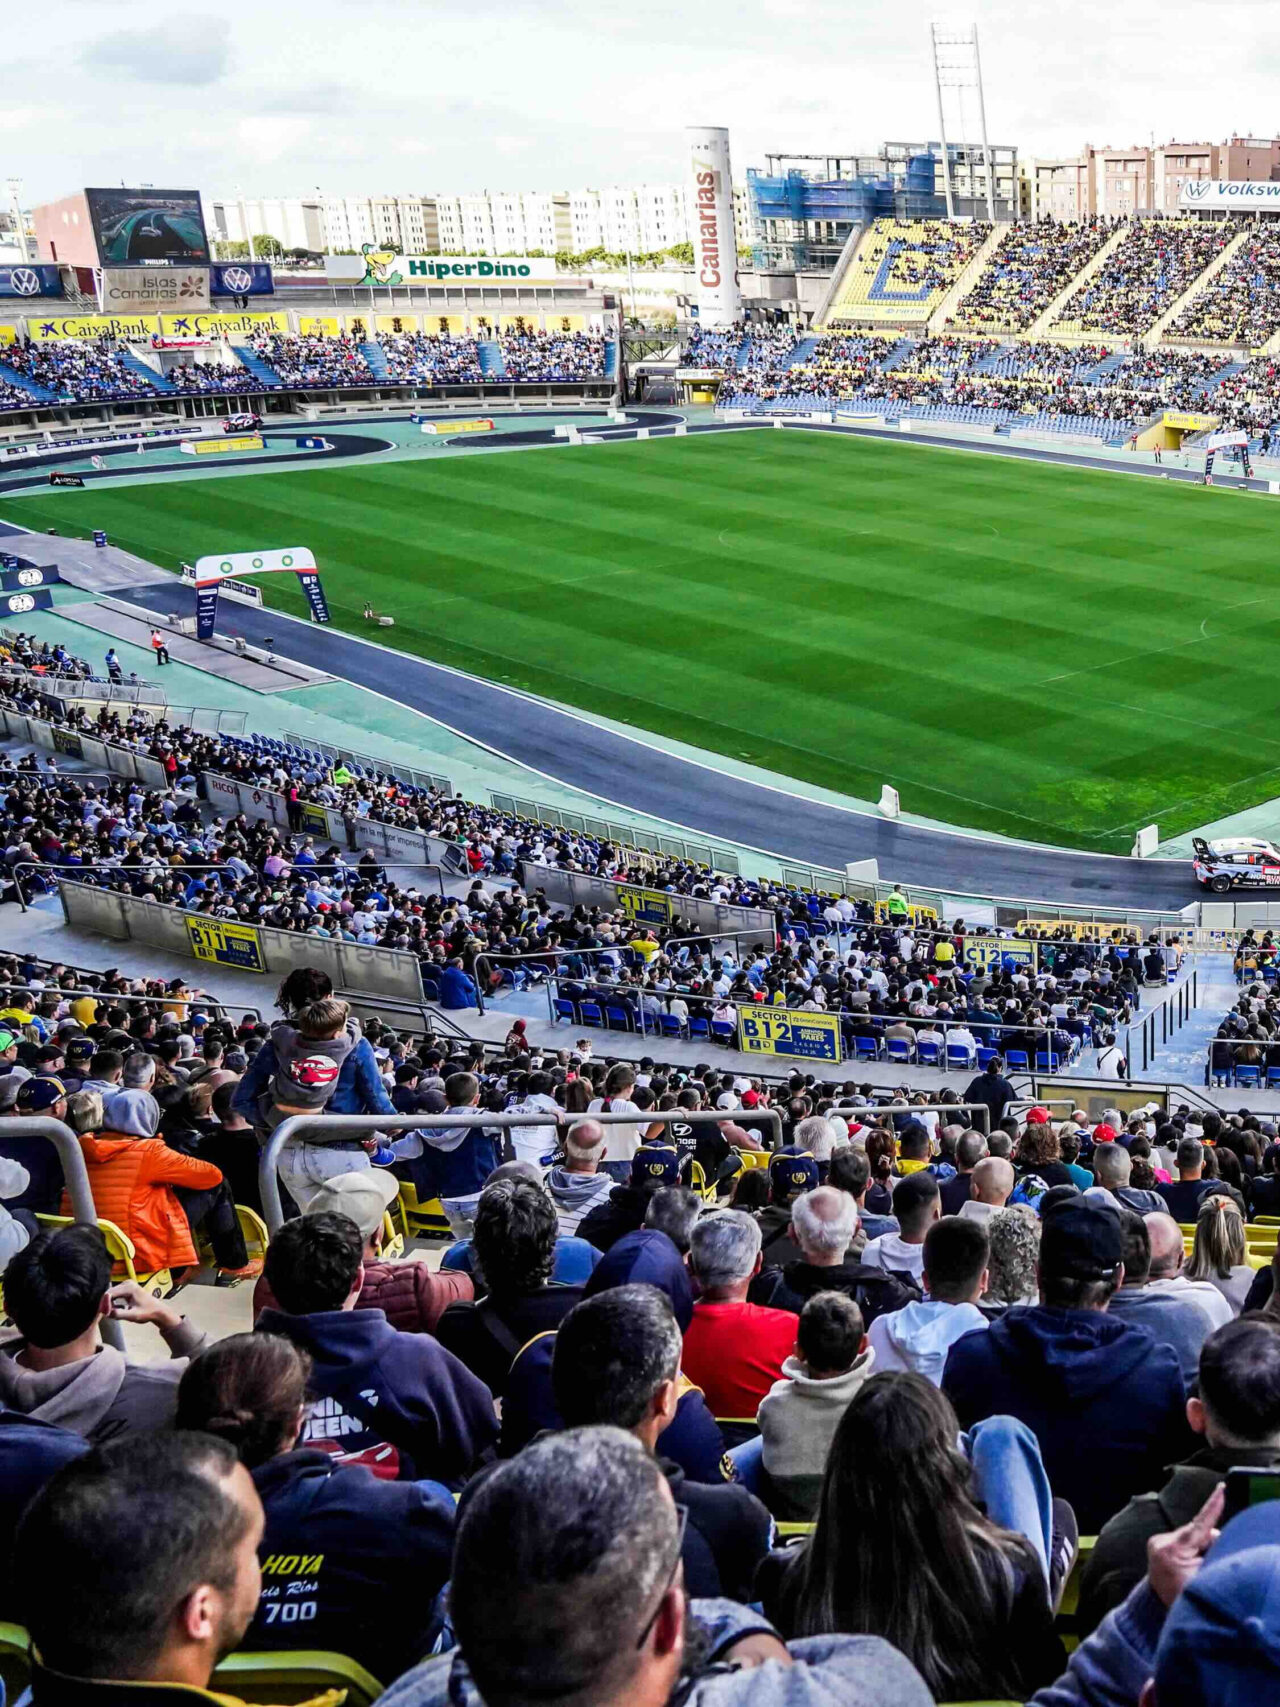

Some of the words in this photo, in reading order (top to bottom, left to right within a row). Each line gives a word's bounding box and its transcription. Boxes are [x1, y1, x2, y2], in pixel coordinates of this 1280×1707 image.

[409, 260, 531, 279] HiperDino
[143, 276, 177, 288] Islas
[109, 287, 177, 299] Canarias
[62, 319, 150, 337] CaixaBank
[194, 316, 280, 333] CaixaBank
[195, 920, 221, 932] SECTOR
[190, 927, 226, 951] B11
[972, 941, 999, 949] SECTOR
[966, 948, 1001, 962] C12
[752, 1011, 788, 1022] SECTOR
[744, 1019, 791, 1040] B12
[801, 1034, 825, 1042] PARES
[260, 1554, 324, 1574] HOYA
[265, 1601, 317, 1623] 700
